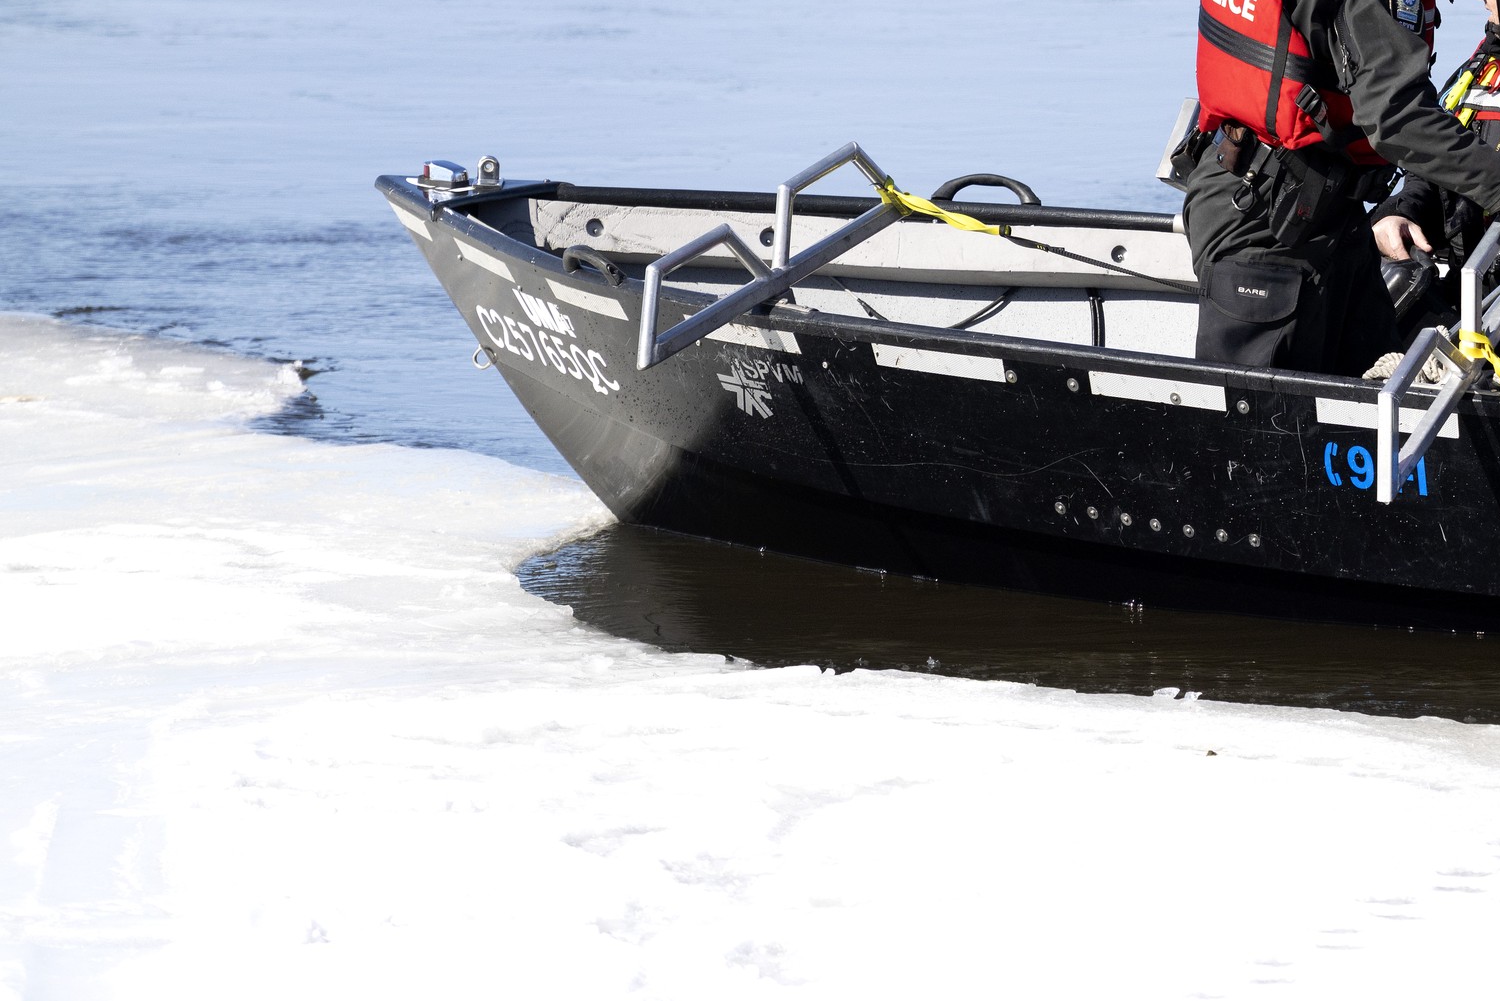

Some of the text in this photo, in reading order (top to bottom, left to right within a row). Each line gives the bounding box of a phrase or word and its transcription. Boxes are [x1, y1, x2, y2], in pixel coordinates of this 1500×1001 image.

[1237, 286, 1266, 297] BARE
[475, 304, 620, 396] C25765QC
[741, 359, 803, 385] SPVM
